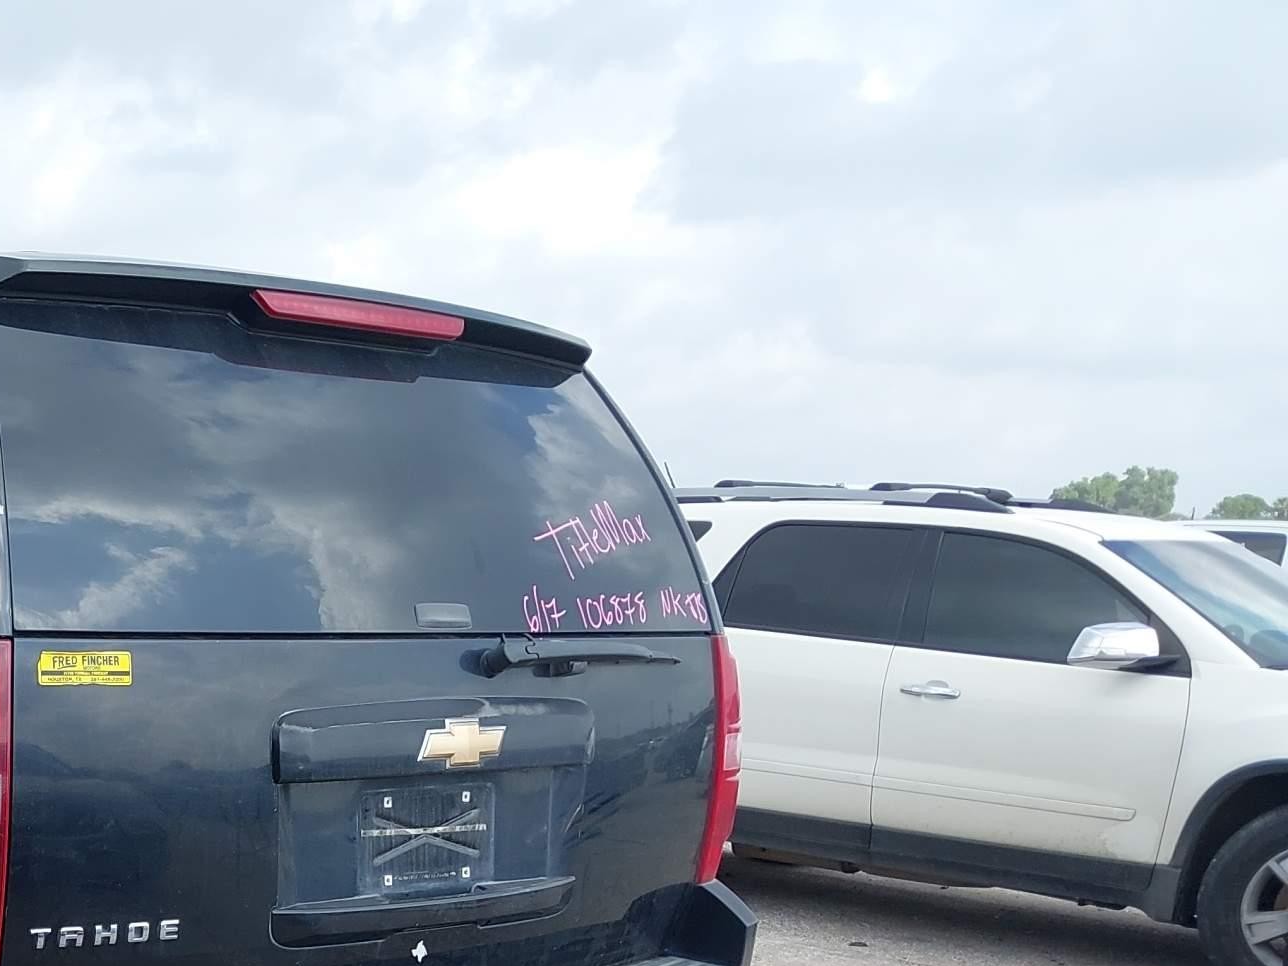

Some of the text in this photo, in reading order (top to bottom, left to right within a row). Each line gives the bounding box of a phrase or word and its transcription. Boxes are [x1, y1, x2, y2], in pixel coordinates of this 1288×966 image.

[534, 500, 652, 580] TitleMax
[523, 585, 567, 633] 6/17
[577, 592, 647, 629] 106878
[52, 655, 120, 669] FRED FINCHER
[30, 919, 180, 949] TAHOE
